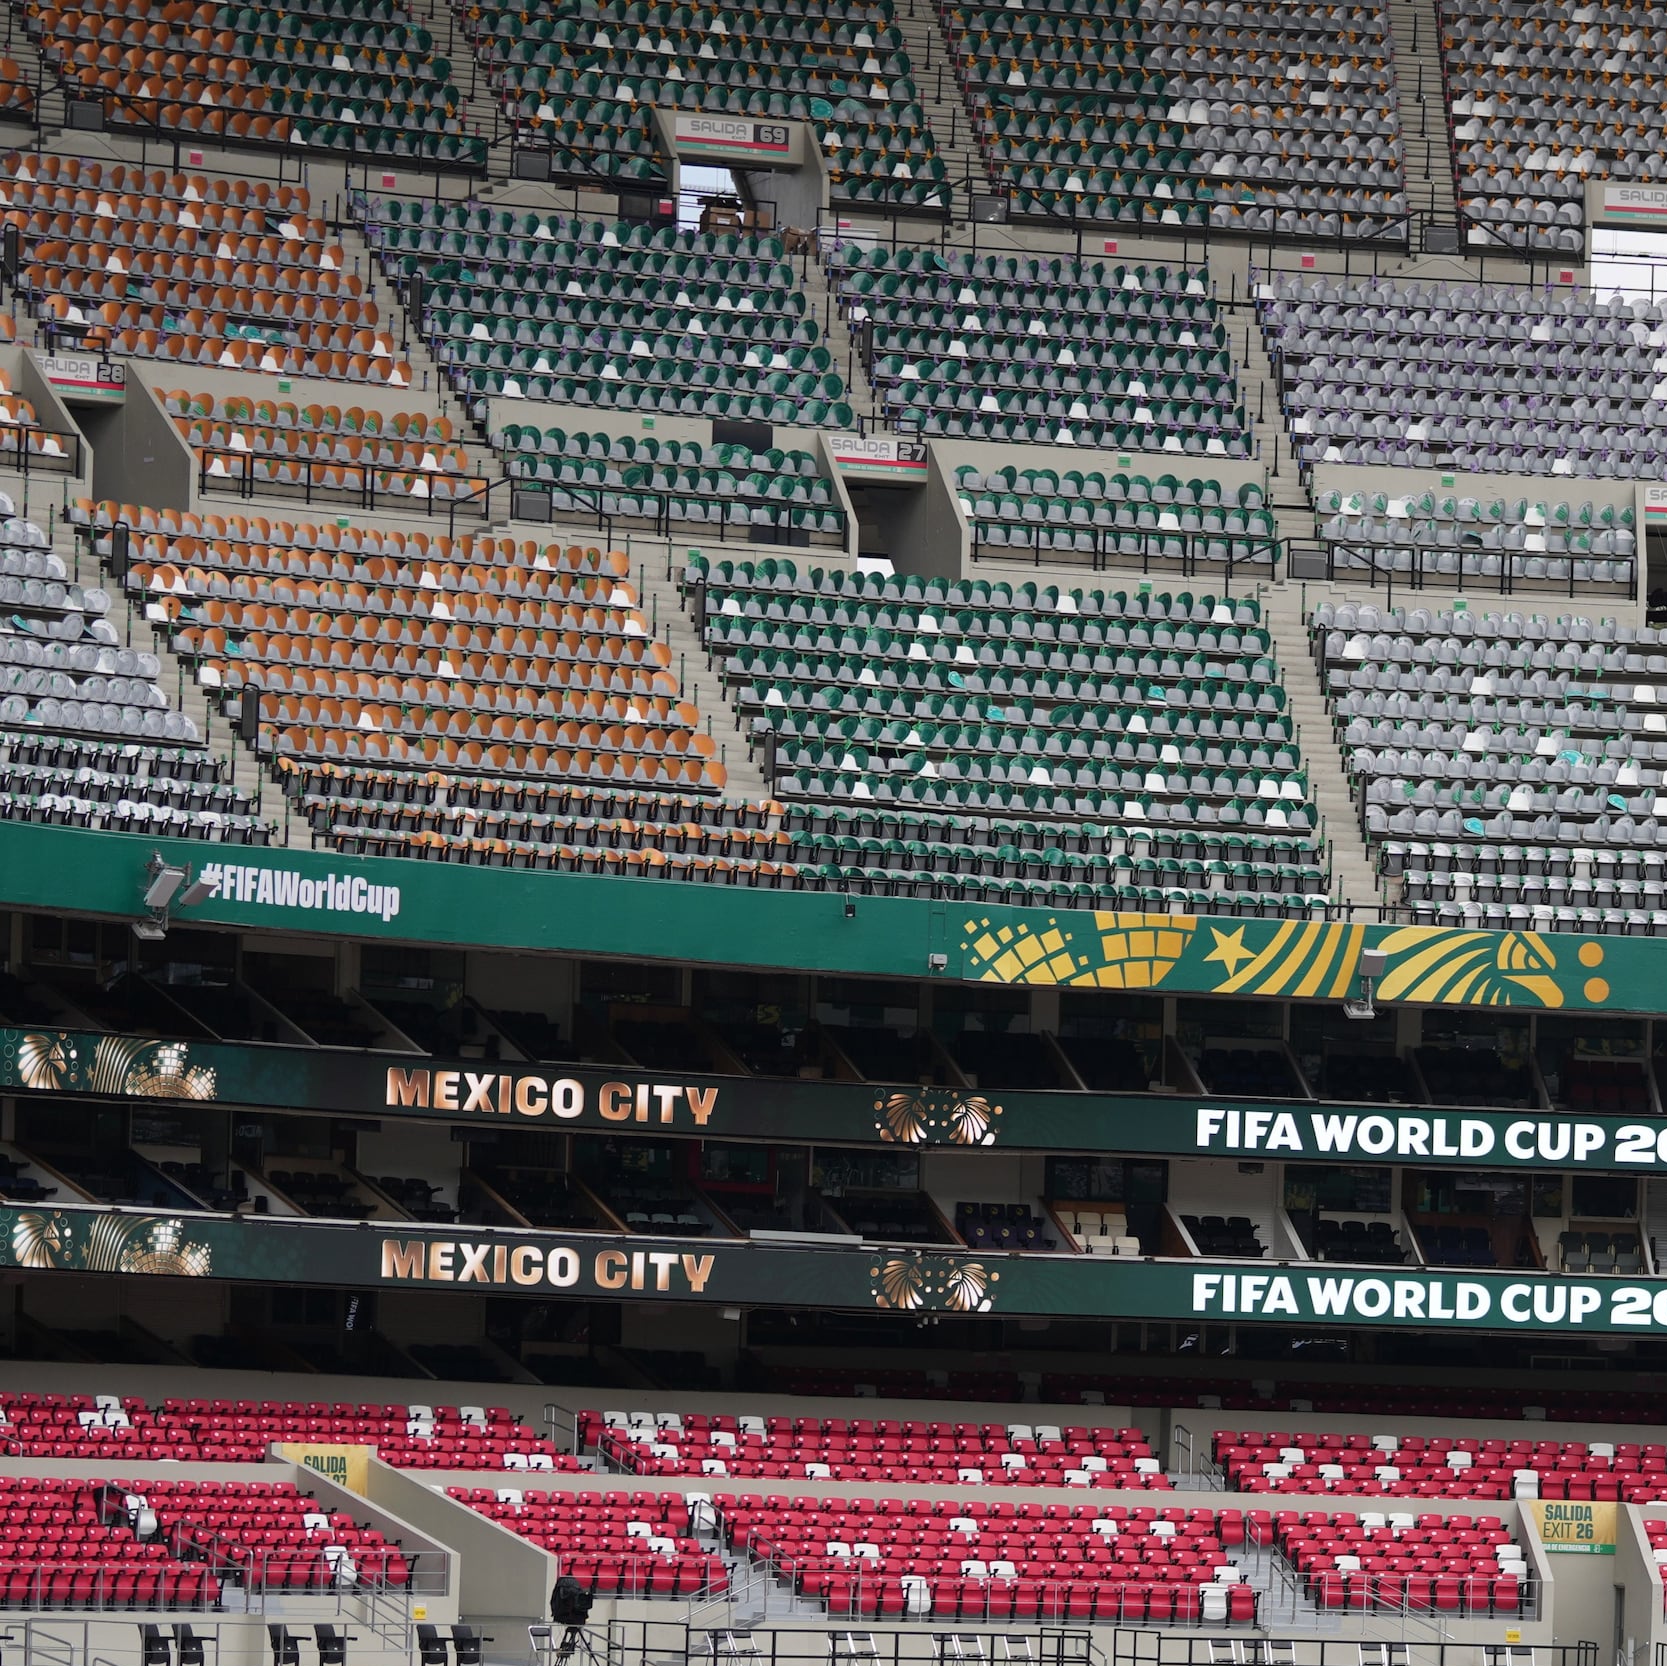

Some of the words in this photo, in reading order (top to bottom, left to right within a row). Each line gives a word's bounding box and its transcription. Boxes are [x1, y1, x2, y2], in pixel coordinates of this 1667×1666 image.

[691, 120, 747, 136] SALIDA
[760, 126, 786, 144] 69
[99, 363, 124, 383] 28
[832, 438, 890, 455] SALIDA
[899, 442, 926, 461] 27
[201, 862, 401, 922] #FIFAWorldCup
[386, 1067, 585, 1119] MEXICO
[599, 1081, 719, 1125] CITY
[1196, 1108, 1303, 1151] FIFA
[1311, 1113, 1495, 1157] WORLD
[1504, 1121, 1606, 1161] CUP
[381, 1239, 581, 1287] MEXICO
[595, 1249, 715, 1293] CITY
[1192, 1273, 1299, 1315] FIFA
[1307, 1277, 1491, 1320] WORLD
[1500, 1283, 1602, 1324] CUP
[304, 1455, 347, 1473] SALIDA
[1544, 1504, 1592, 1521] SALIDA
[1543, 1522, 1572, 1539] EXIT
[1576, 1523, 1594, 1540] 26
